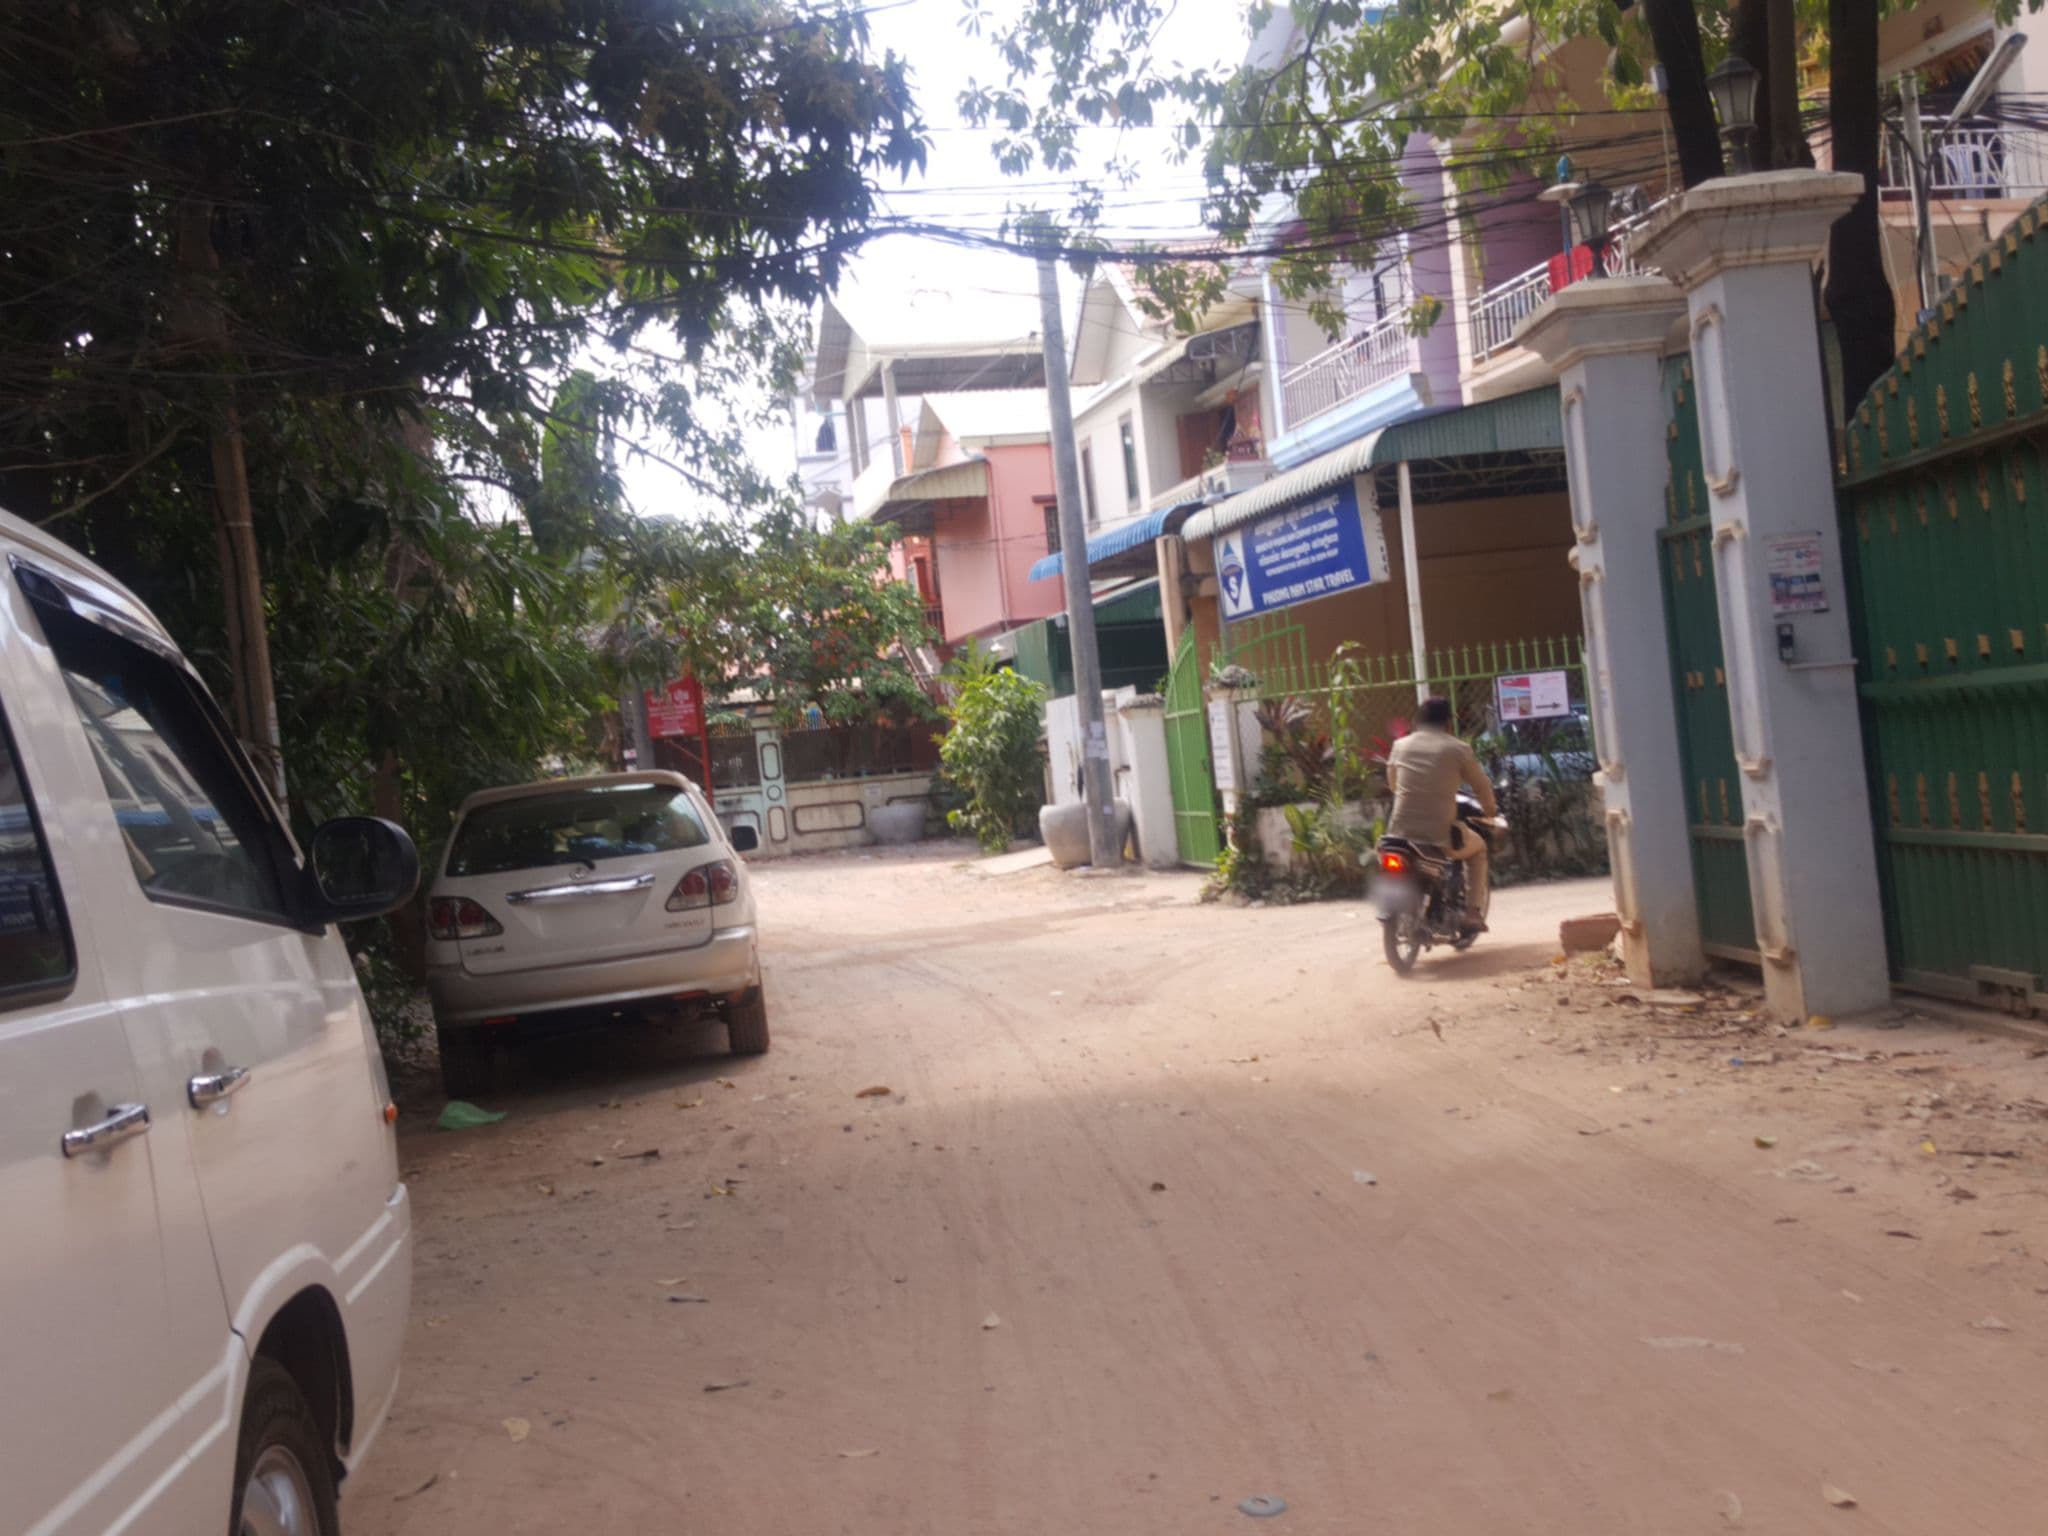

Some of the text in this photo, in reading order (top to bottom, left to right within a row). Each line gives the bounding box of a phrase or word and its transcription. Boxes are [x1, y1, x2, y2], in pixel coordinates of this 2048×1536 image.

[1229, 577, 1239, 598] S
[1305, 577, 1326, 593] STAR
[1325, 568, 1354, 587] TRAVEL
